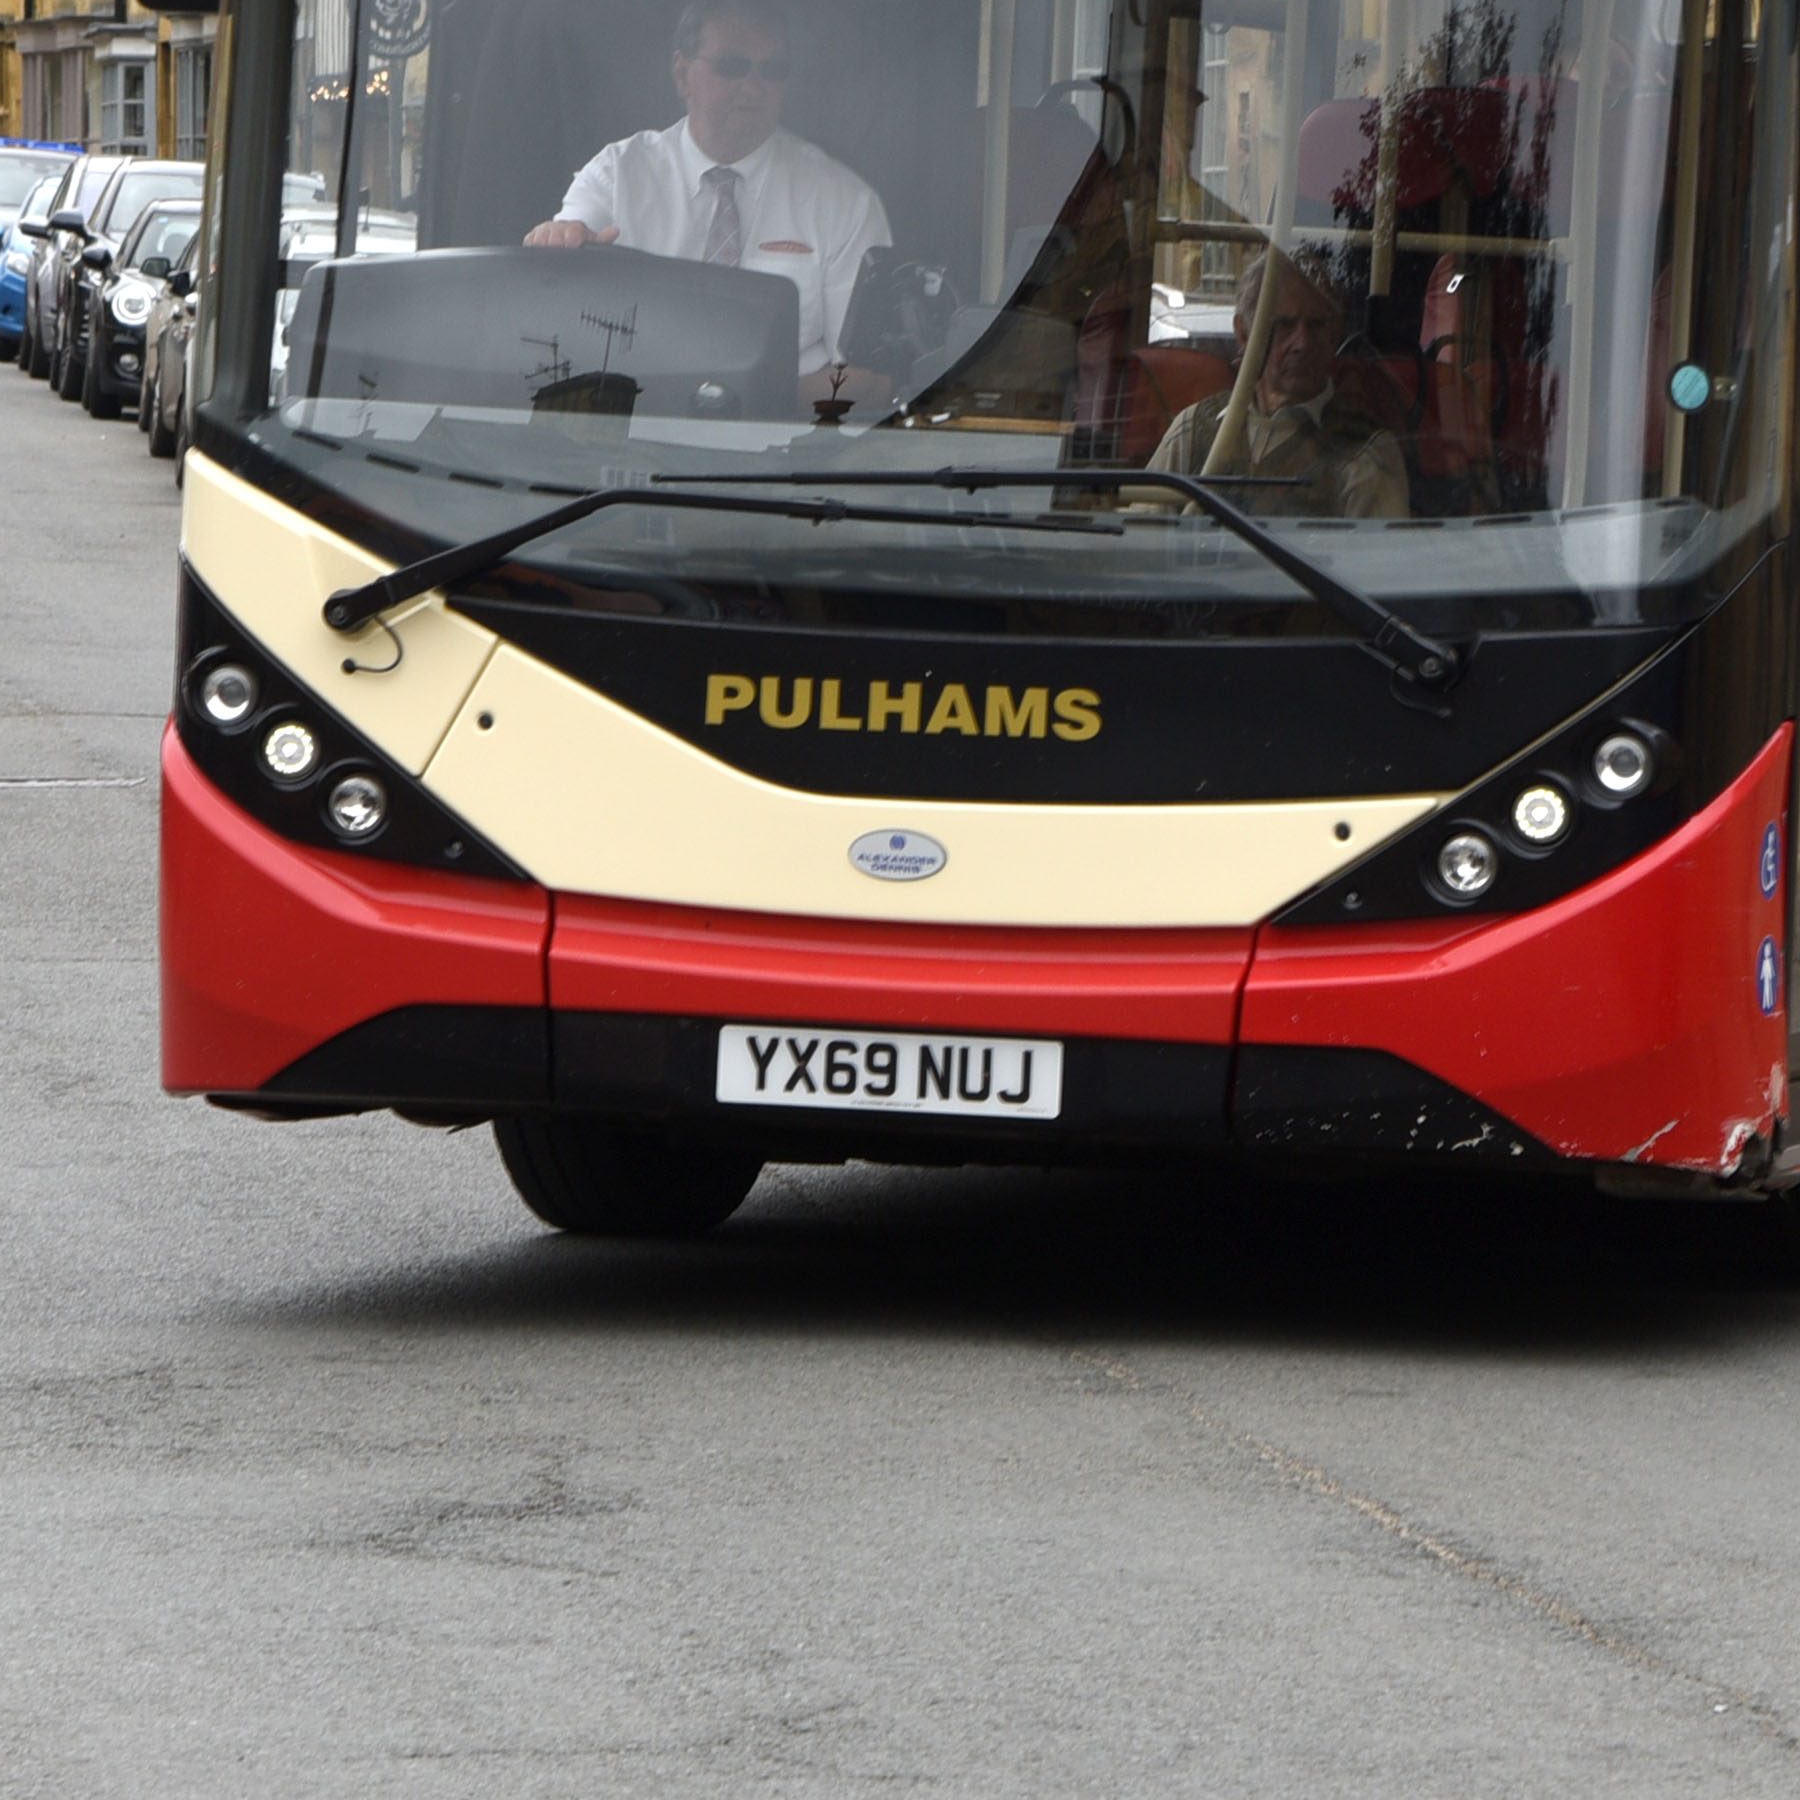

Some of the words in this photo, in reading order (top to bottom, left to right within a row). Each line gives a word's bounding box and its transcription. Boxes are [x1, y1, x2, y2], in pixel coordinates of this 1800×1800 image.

[703, 673, 1103, 743] PULHAMS
[746, 1035, 898, 1097] YX69
[916, 1043, 1033, 1105] NUJ
